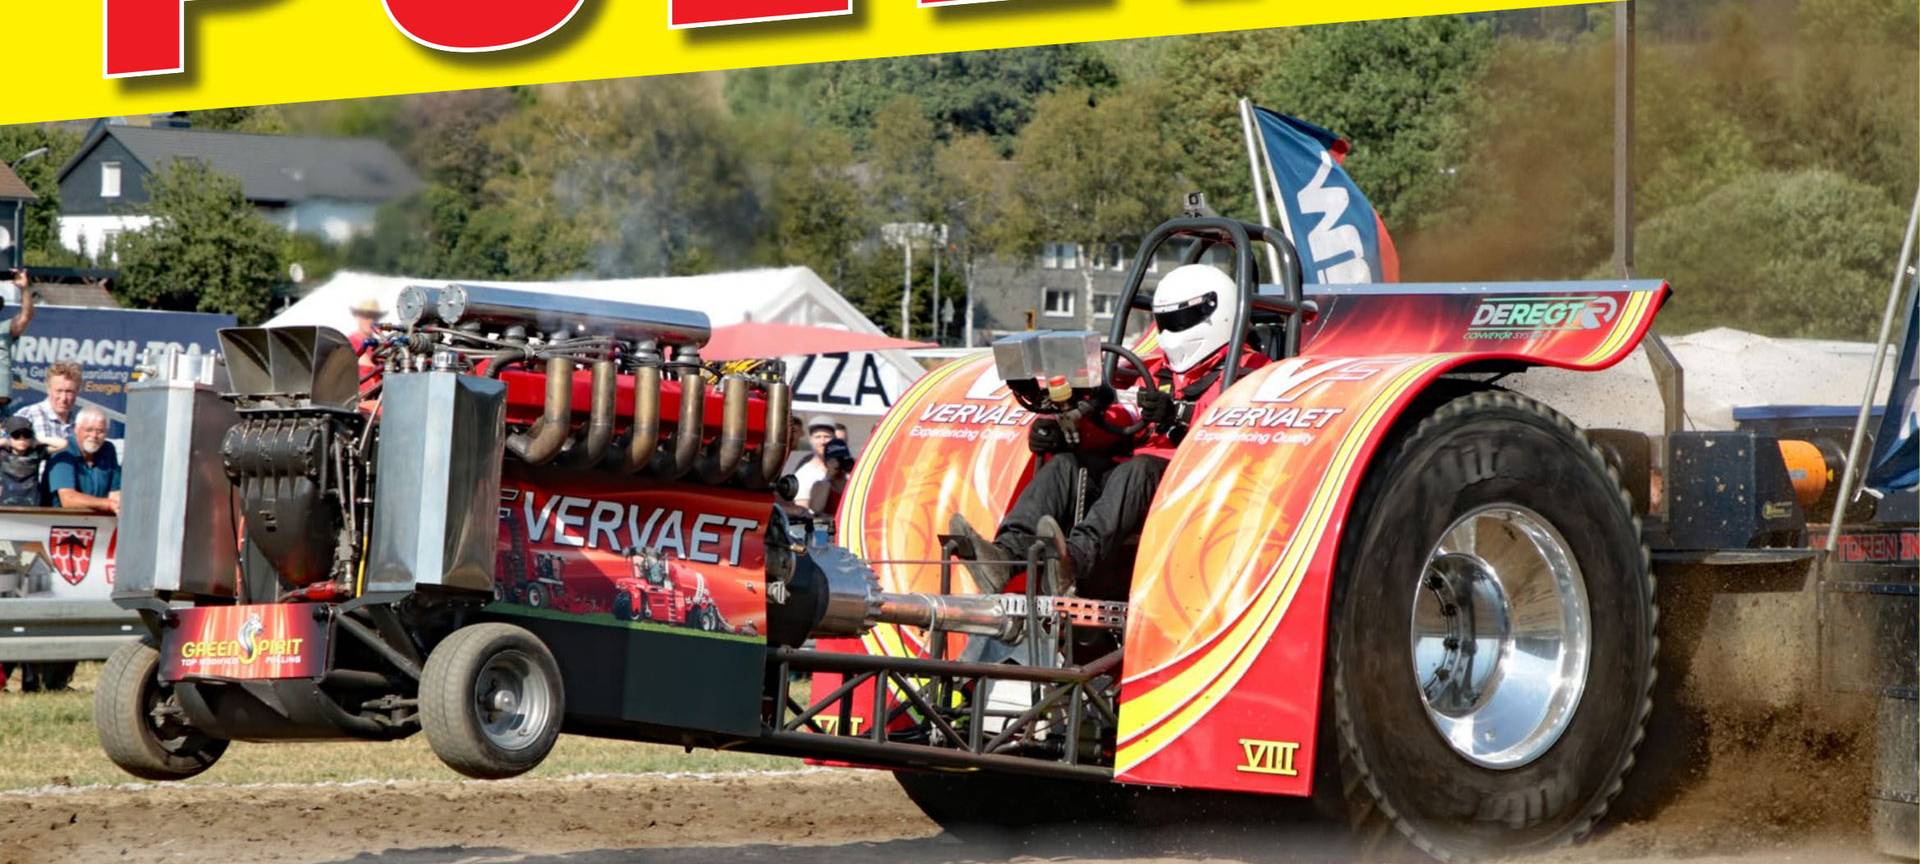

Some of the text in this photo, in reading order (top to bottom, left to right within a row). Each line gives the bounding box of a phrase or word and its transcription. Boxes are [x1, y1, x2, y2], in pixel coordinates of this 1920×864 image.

[1203, 407, 1345, 429] VERVAET
[1271, 430, 1317, 446] Quality
[523, 490, 760, 567] VERVAET
[181, 639, 240, 658] GREEN
[181, 658, 198, 667] TOP
[1236, 737, 1300, 776] VIII
